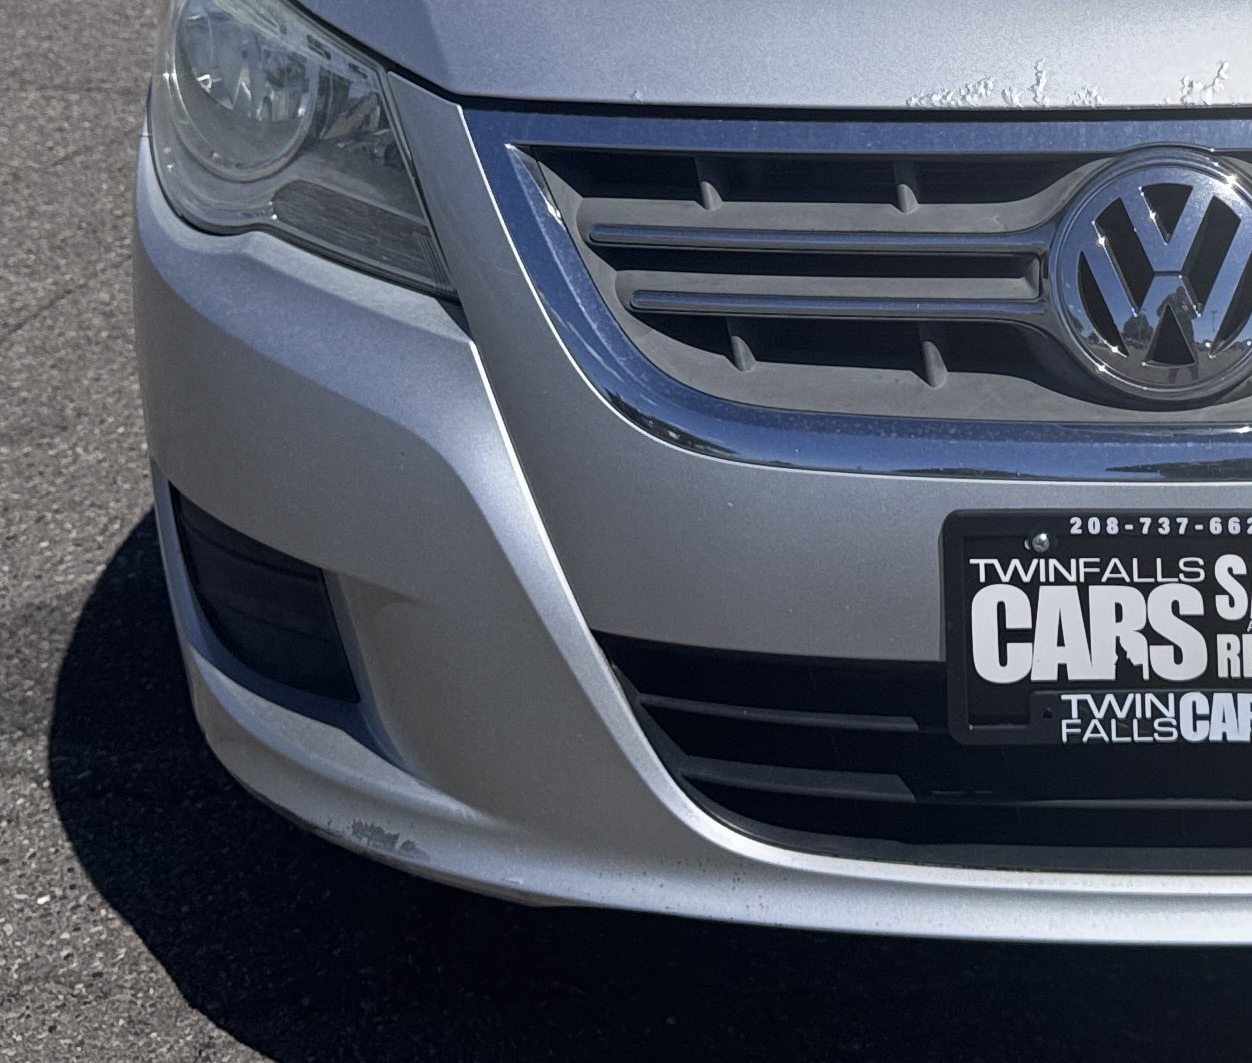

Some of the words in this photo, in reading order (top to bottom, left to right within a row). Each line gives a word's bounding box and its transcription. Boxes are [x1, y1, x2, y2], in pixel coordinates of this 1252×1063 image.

[971, 583, 1209, 684] CARS
[1060, 692, 1176, 719] TWIN
[1060, 717, 1179, 744] FALLS
